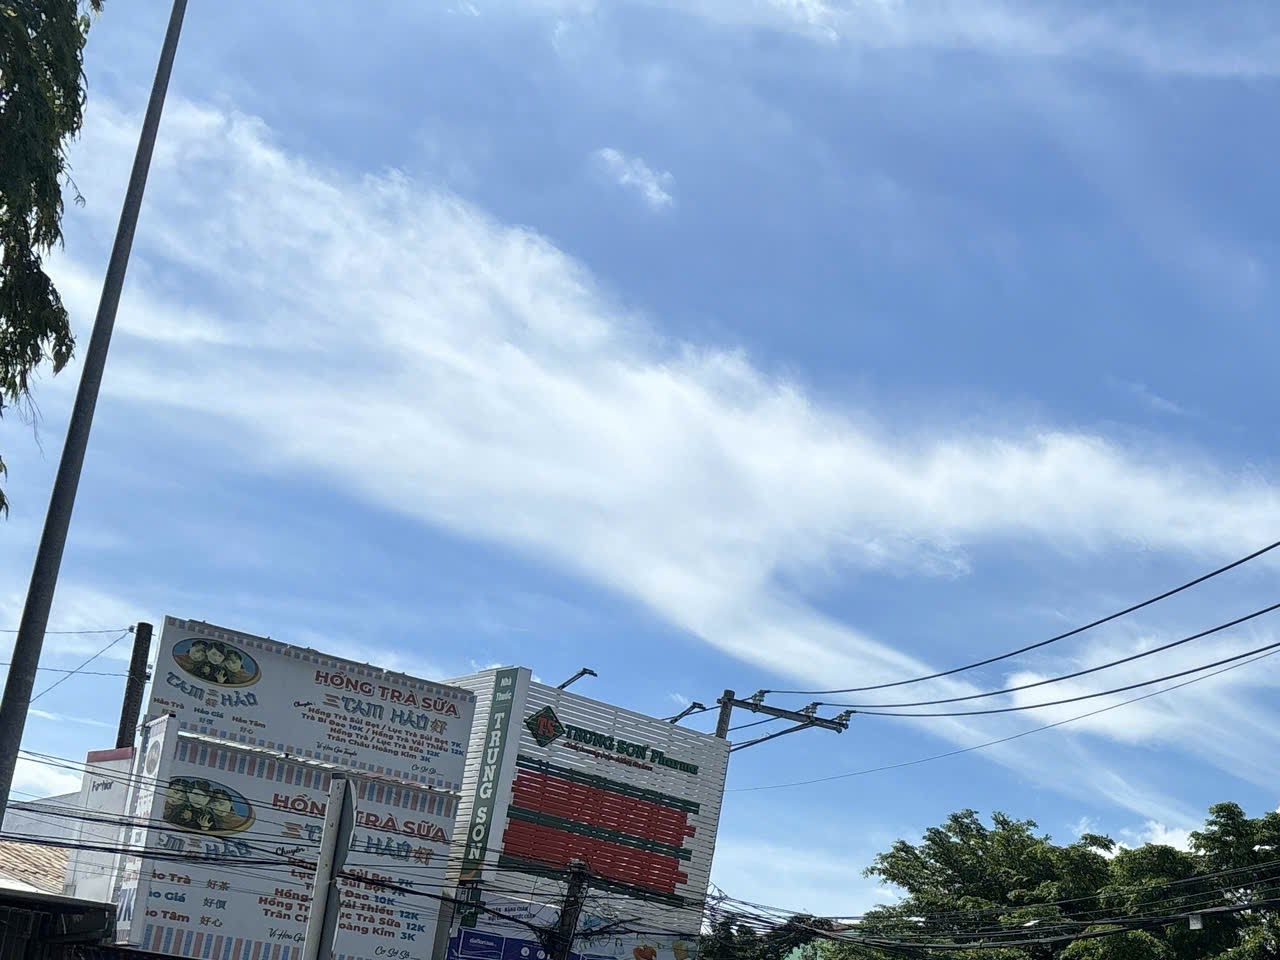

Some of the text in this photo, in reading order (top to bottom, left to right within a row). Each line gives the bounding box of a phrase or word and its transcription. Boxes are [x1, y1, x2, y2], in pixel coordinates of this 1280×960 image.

[314, 669, 460, 718] HỒNG TRÀ SỮA
[349, 724, 364, 732] 10K
[479, 712, 505, 799] TRUNG
[272, 793, 326, 816] HỒN
[402, 820, 450, 841] SỮA
[373, 894, 396, 906] 10K
[263, 908, 291, 921] Trân
[338, 922, 369, 935] oàng
[372, 927, 396, 939] Kim
[400, 931, 416, 942] 3K
[356, 912, 376, 924] Trà
[379, 916, 401, 928] Sữa
[406, 922, 426, 933] 12K
[399, 910, 420, 921] 12K
